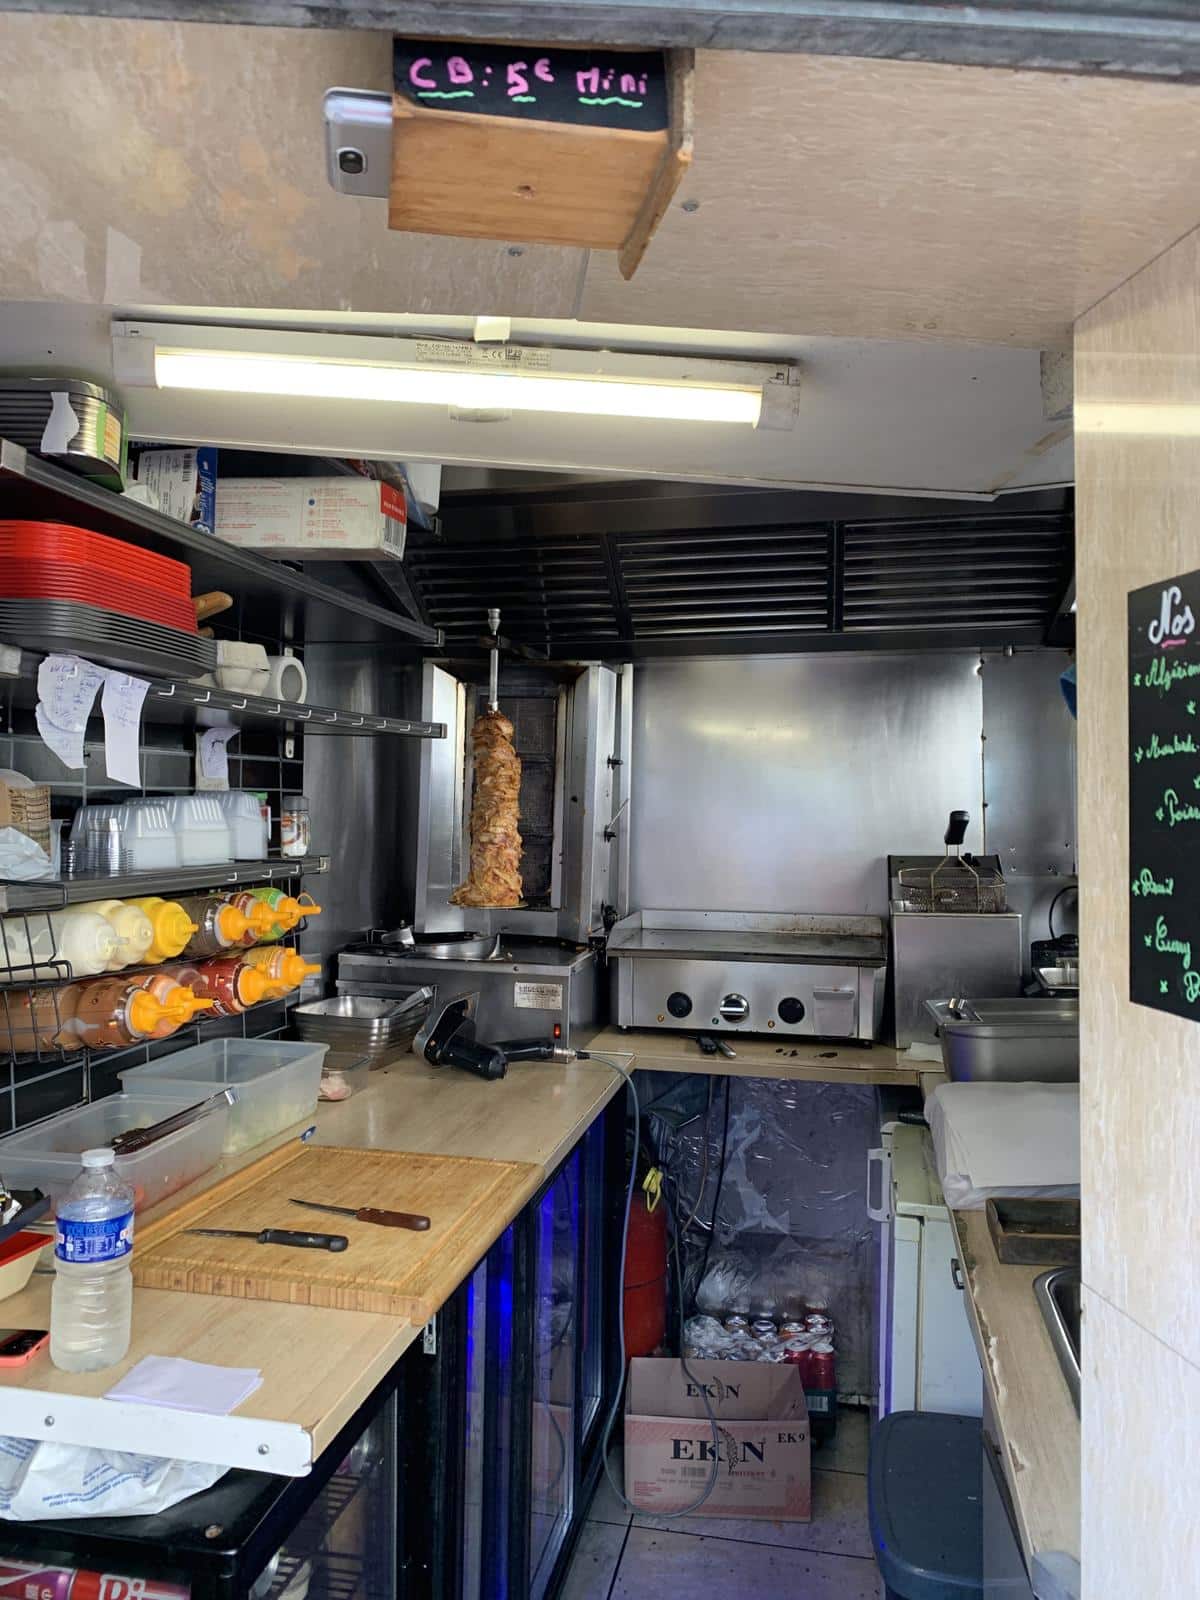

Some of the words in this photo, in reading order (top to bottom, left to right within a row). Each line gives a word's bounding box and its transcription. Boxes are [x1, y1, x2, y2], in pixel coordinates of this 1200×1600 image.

[507, 57, 555, 96] 5€
[576, 67, 648, 95] Mini
[1148, 585, 1195, 645] Nos
